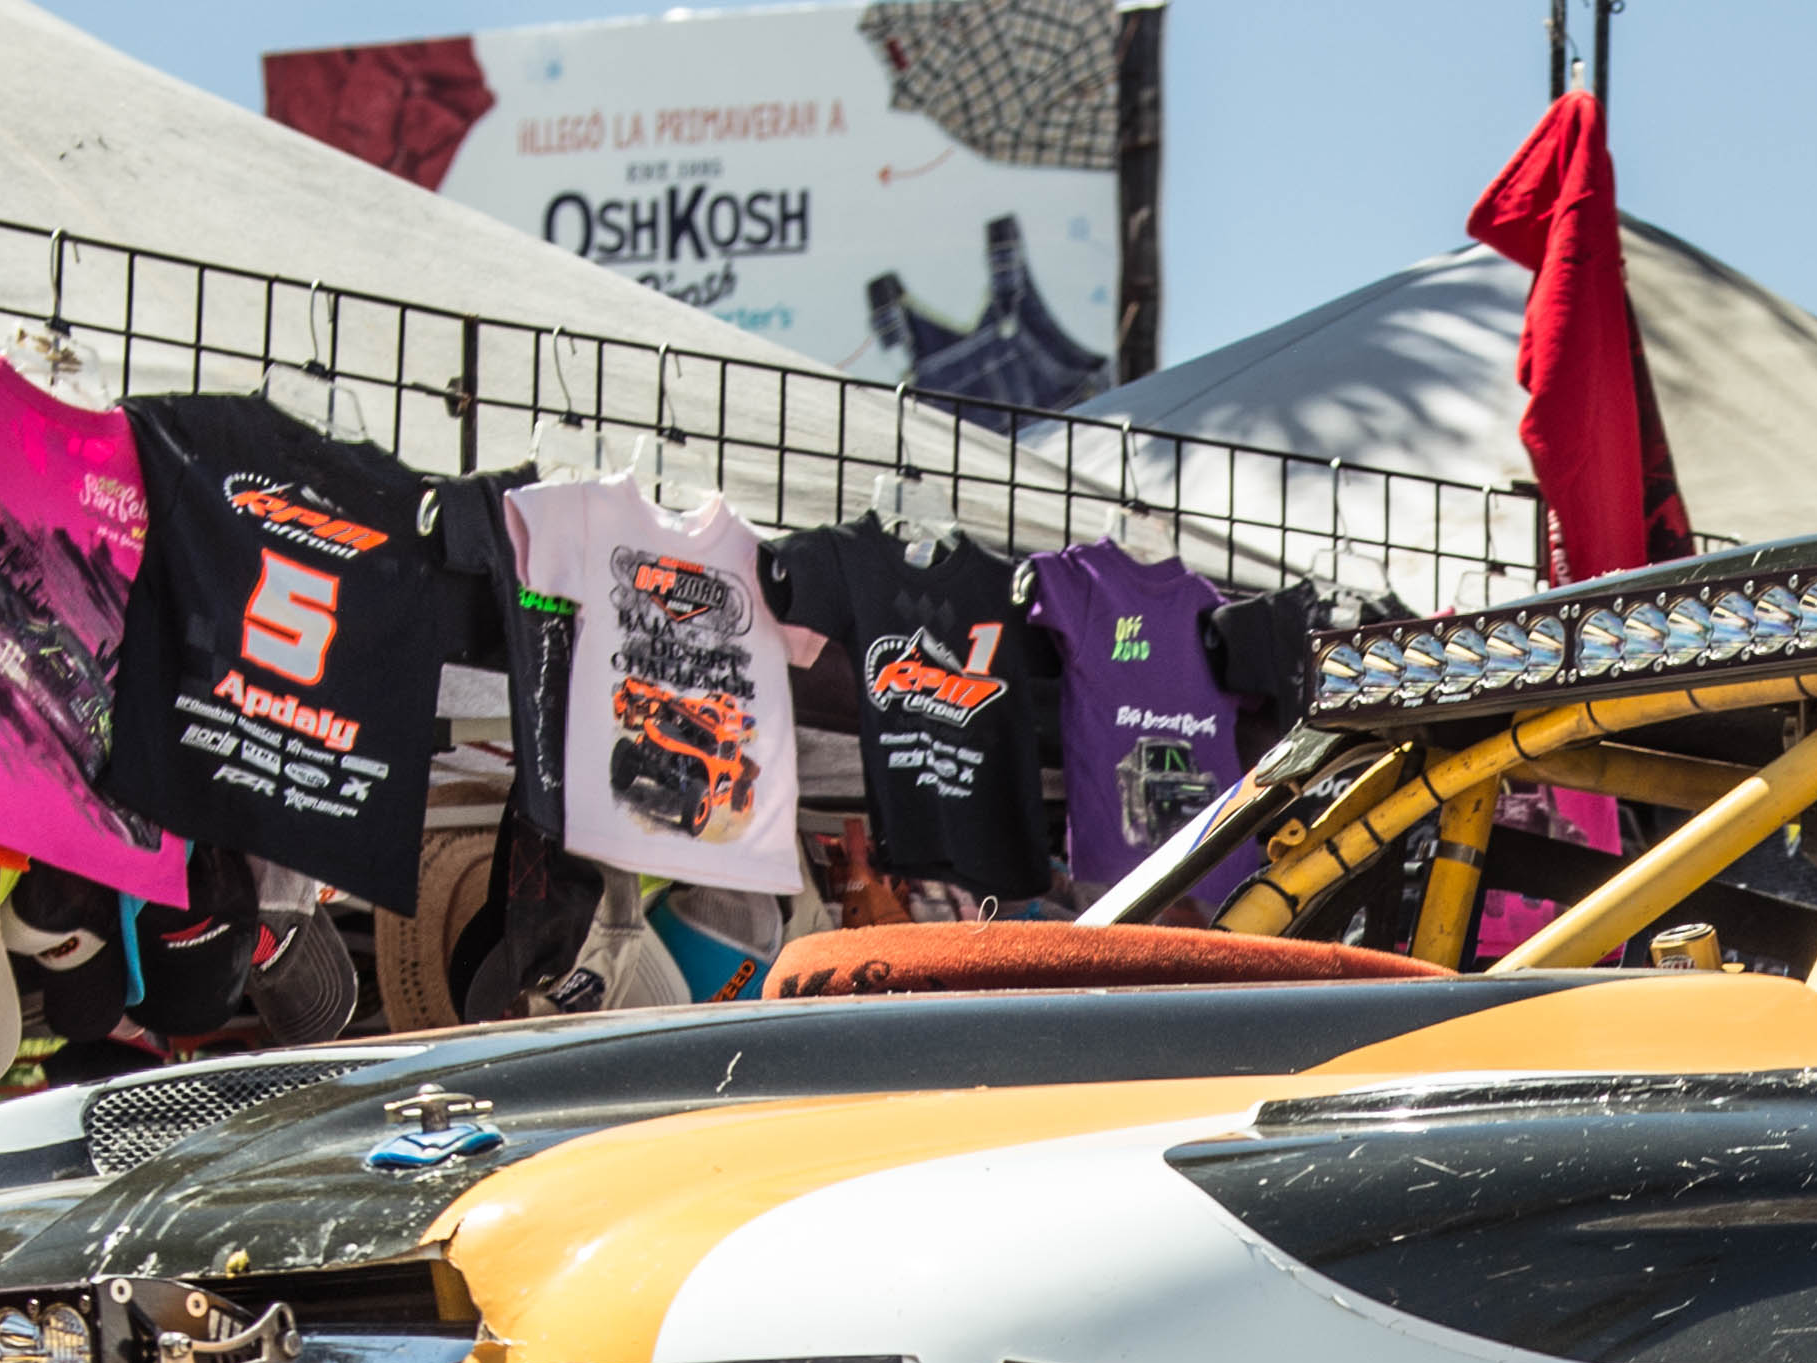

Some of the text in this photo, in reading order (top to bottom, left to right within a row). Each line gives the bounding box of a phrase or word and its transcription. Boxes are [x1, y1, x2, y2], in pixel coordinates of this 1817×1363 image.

[612, 111, 644, 149] LA
[240, 547, 341, 687] 5
[963, 622, 1004, 677] 1
[872, 659, 1001, 709] RPM
